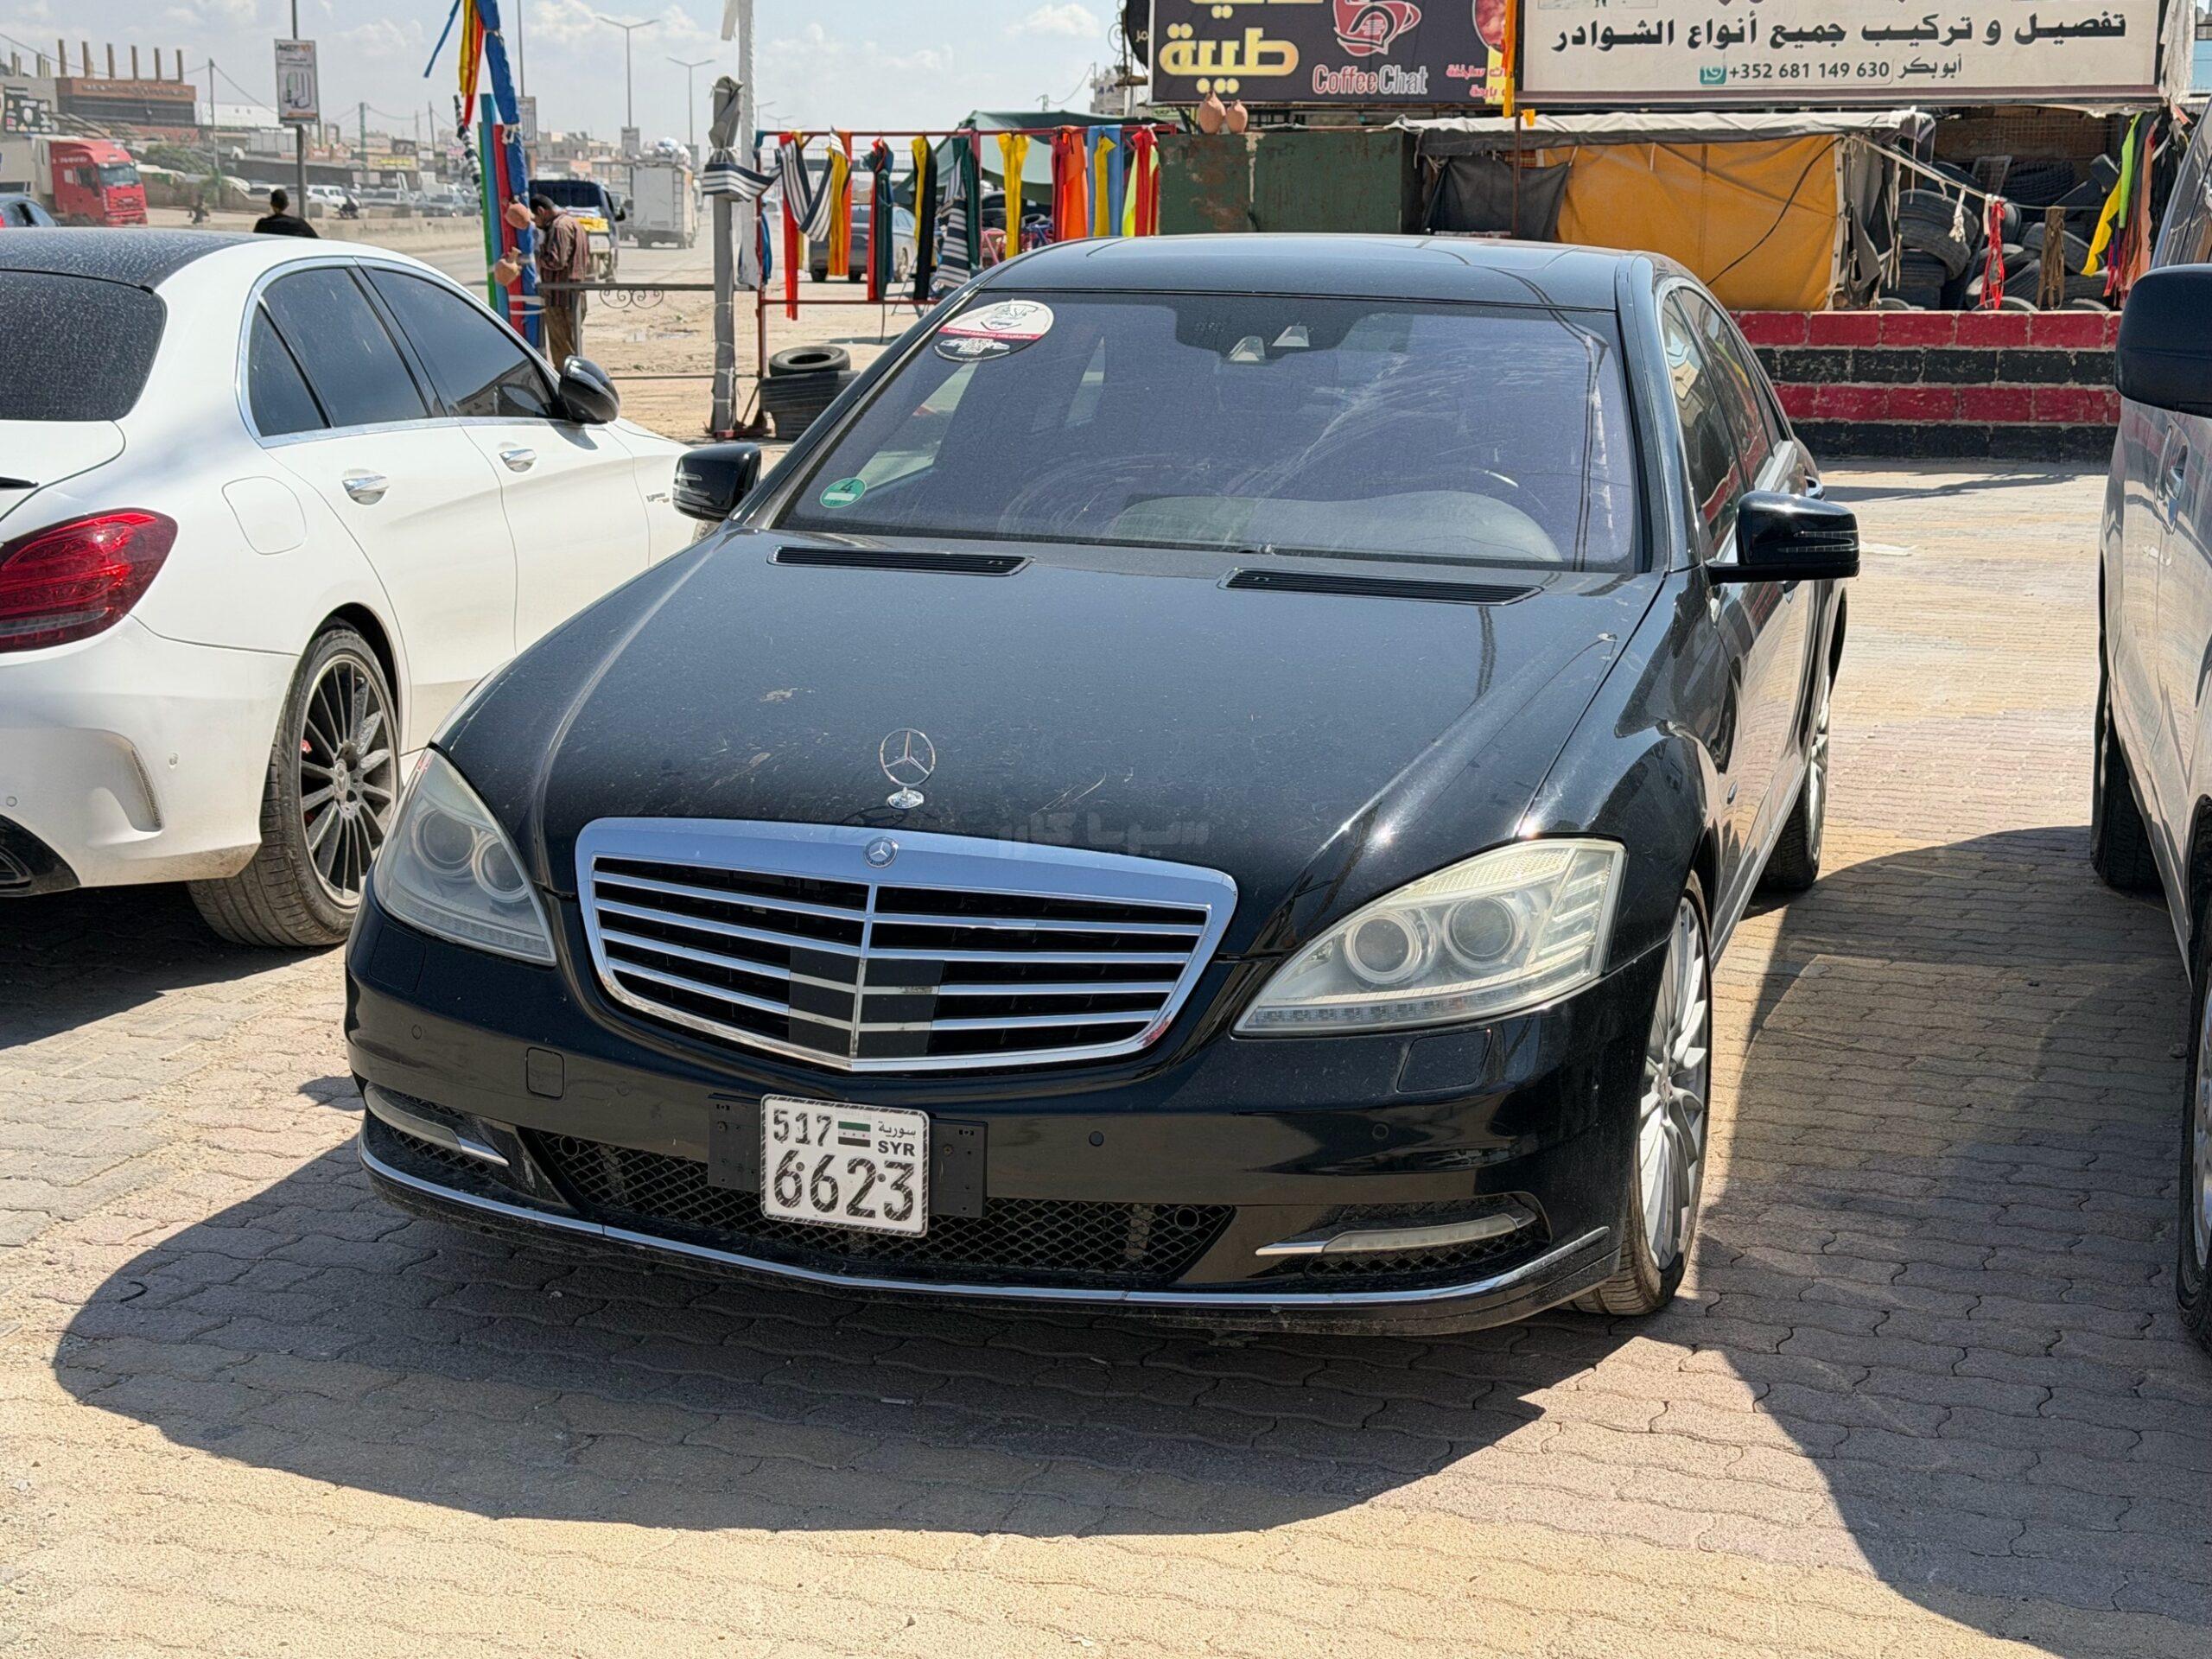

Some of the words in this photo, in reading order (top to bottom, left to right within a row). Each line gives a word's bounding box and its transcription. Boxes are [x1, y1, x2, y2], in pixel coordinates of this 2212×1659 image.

[1551, 18, 1675, 52] الشوادر
[1687, 10, 1757, 49] أنواع
[1769, 22, 1847, 49] جميع
[1861, 13, 1974, 47] تركيب
[1982, 19, 2002, 46] و
[2014, 11, 2126, 45] تفصيل
[1159, 22, 1299, 93] طيبة
[1729, 63, 1772, 79] +352
[1778, 63, 1810, 79] 681
[1819, 62, 1850, 79] 149
[1856, 61, 1891, 78] 630
[772, 1109, 833, 1147] 517
[878, 1121, 917, 1140] سورية
[877, 1140, 916, 1157] SYR
[773, 1149, 915, 1222] 6623
